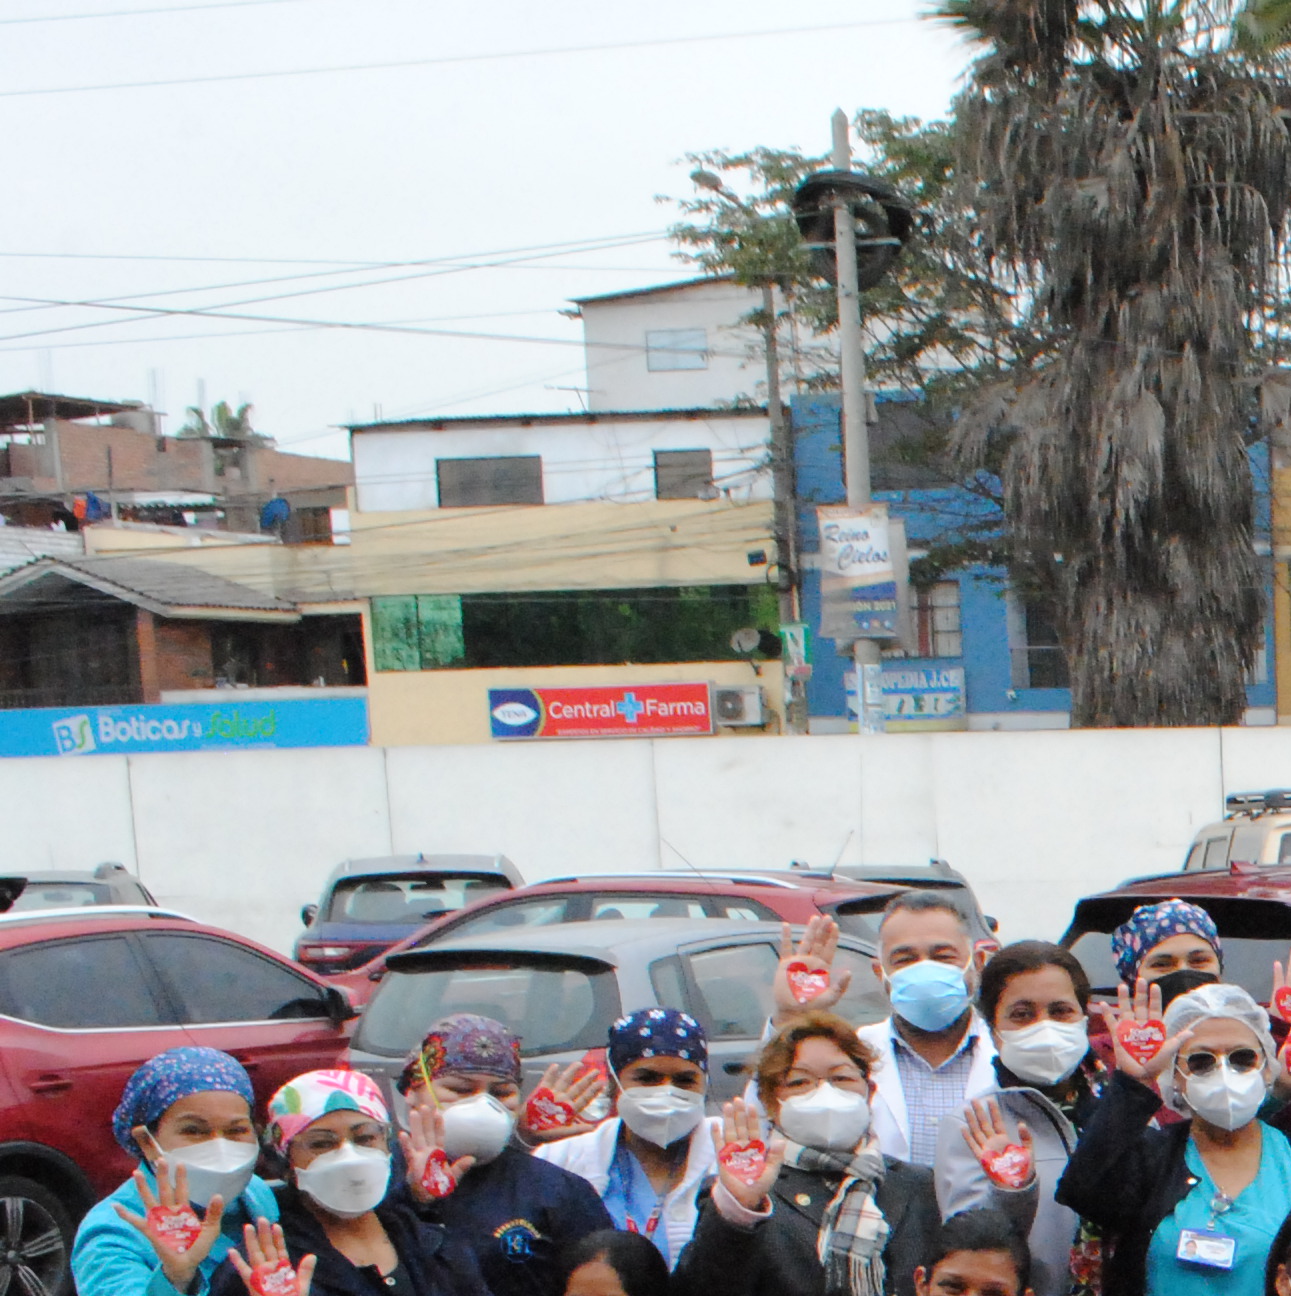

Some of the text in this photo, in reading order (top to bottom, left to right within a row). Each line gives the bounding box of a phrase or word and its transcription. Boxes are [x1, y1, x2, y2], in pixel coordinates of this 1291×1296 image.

[824, 523, 871, 543] Reino
[837, 543, 889, 571] Cielos
[549, 699, 706, 719] Central Farma
[98, 709, 276, 743] Boticas y Salud
